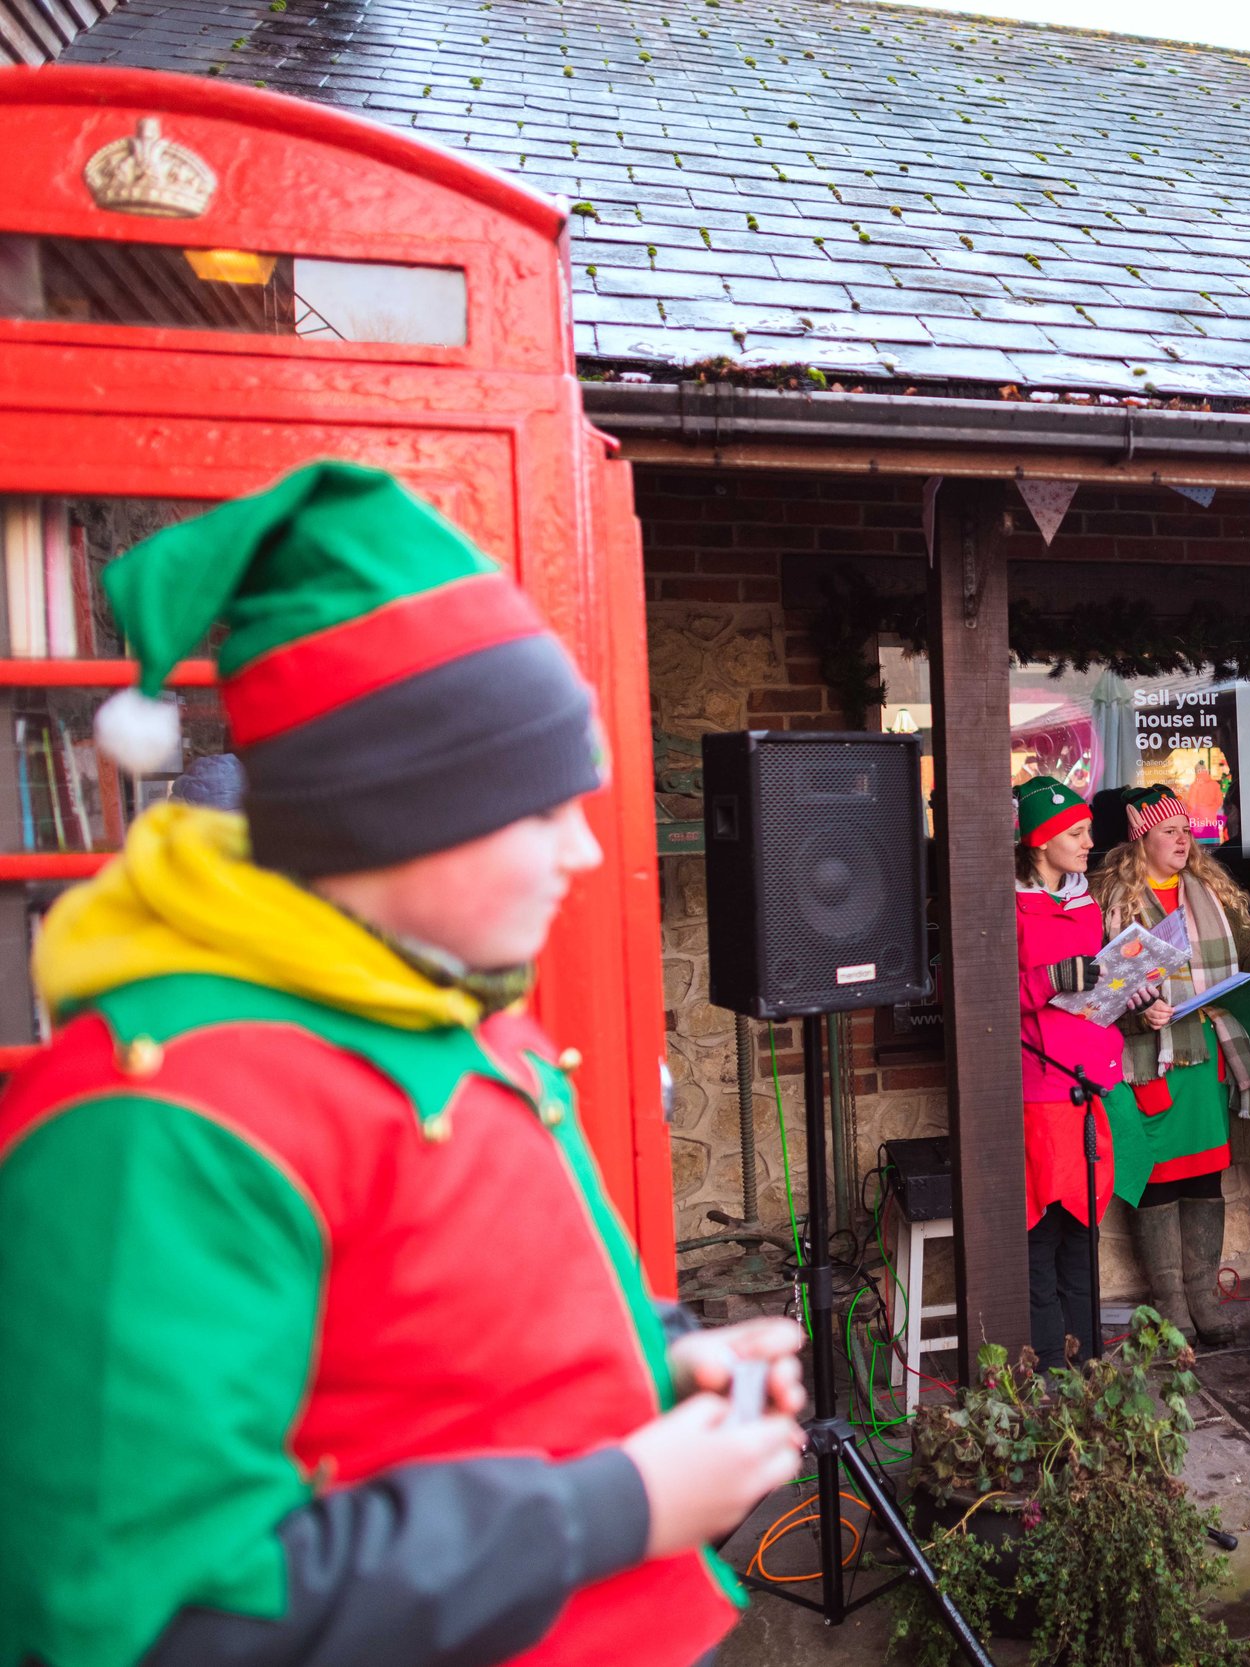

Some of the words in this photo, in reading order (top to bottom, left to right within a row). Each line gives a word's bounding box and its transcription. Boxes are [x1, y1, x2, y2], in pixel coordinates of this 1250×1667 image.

[1133, 689, 1170, 706] Sell
[1175, 692, 1219, 710] your
[1135, 711, 1194, 728] house
[1199, 709, 1217, 727] in
[1135, 732, 1162, 750] 60
[1168, 732, 1213, 753] days
[1189, 818, 1224, 829] Bishop
